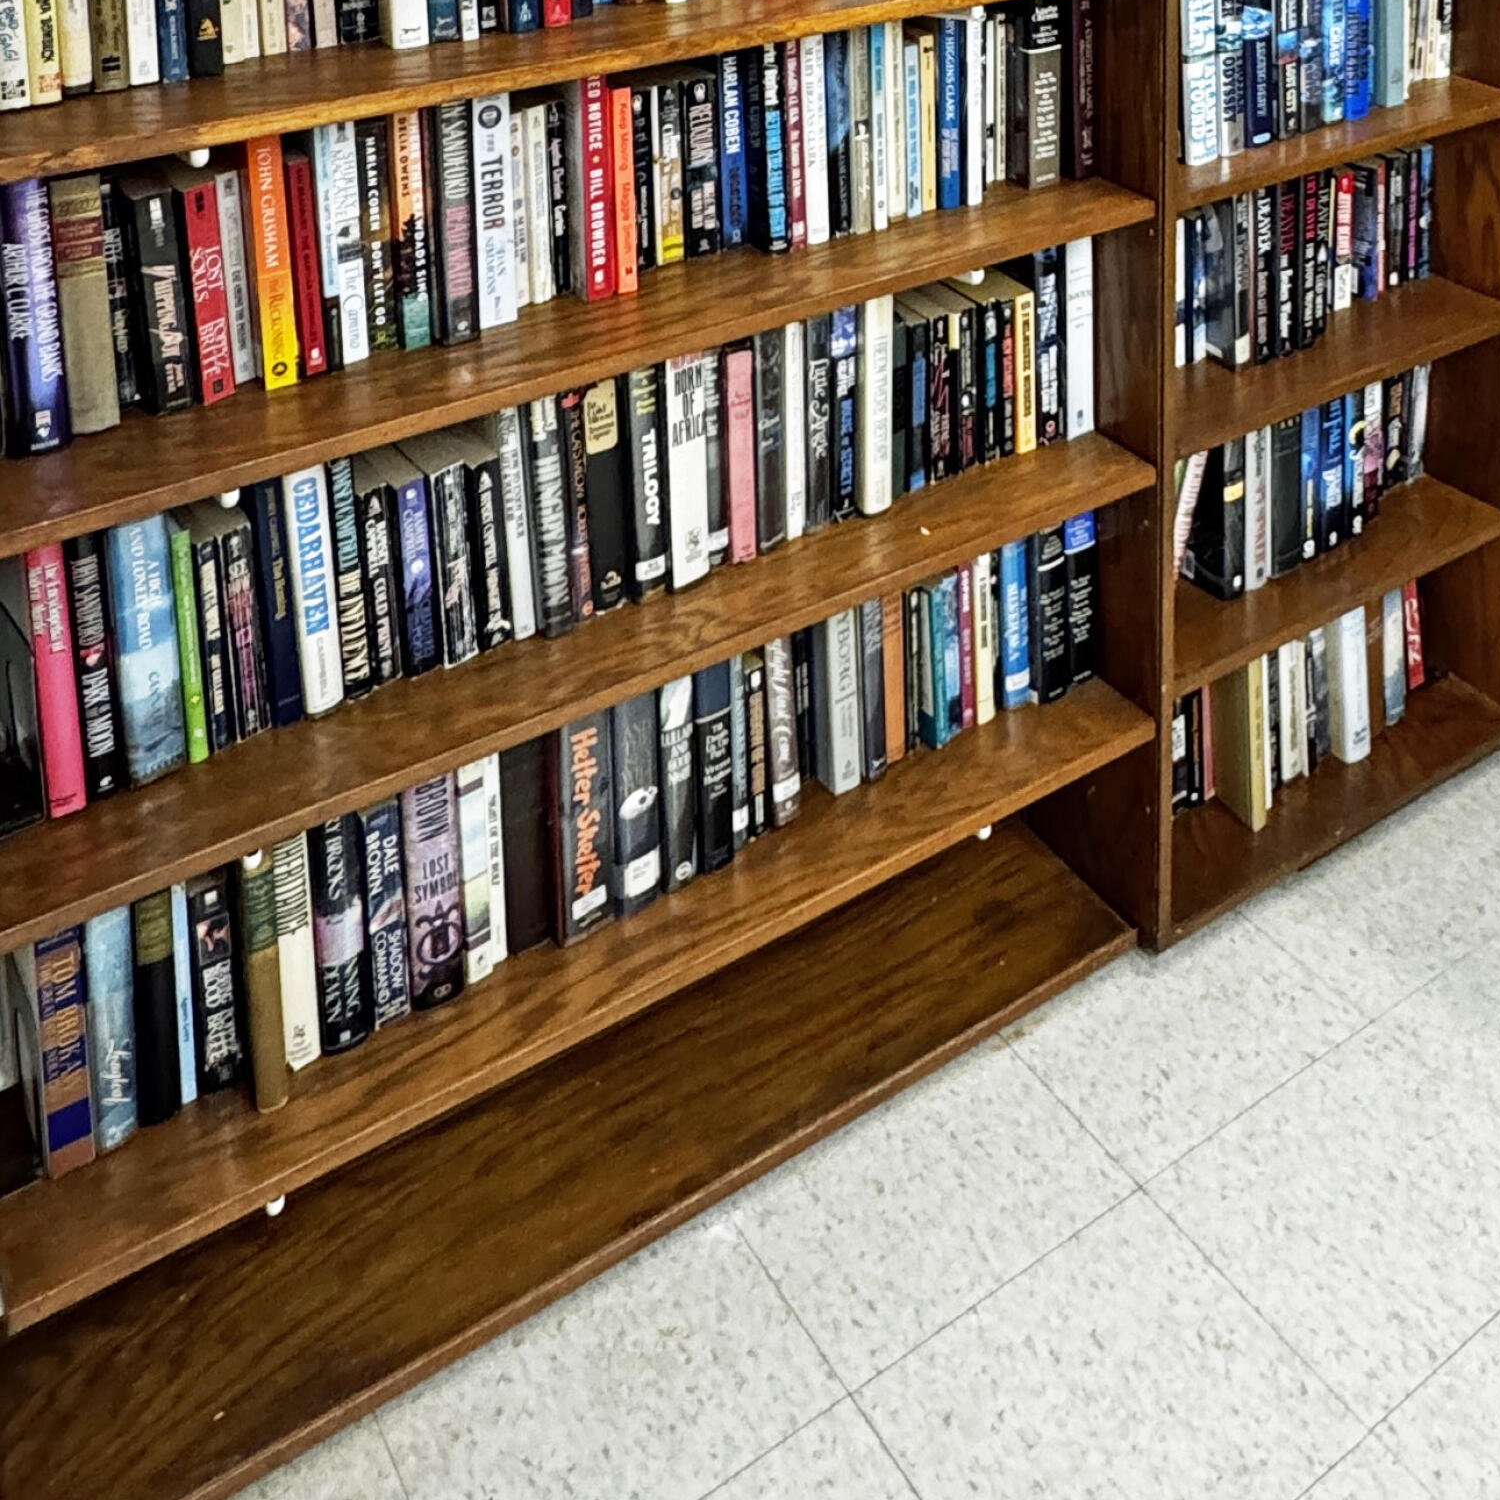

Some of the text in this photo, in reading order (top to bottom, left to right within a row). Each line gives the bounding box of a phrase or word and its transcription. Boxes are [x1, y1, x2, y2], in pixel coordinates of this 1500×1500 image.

[723, 57, 741, 154] HARLAN COBEN
[1222, 56, 1237, 124] ODYSSEY
[397, 117, 410, 198] DELIA OWENS
[441, 122, 470, 200] SANDFORD
[689, 103, 714, 169] RELIQUARY
[256, 146, 279, 269] JOHN GRISHAM
[365, 137, 381, 231] HARLAN COBEN
[481, 155, 506, 231] TERROR
[588, 102, 606, 267] NOTICE BILL BROWDER
[190, 248, 209, 304] SOULS
[205, 246, 223, 291] LOST
[371, 241, 386, 325] DON'T LET GO
[446, 206, 473, 299] DEAD WATCH
[674, 366, 702, 394] HORN
[683, 397, 696, 418] OF
[672, 416, 706, 448] AFRICA
[641, 429, 660, 525] TRILOGY
[293, 477, 329, 636] CEDARHAVEN
[415, 776, 447, 843] BROWN
[570, 727, 601, 896] Helter Skelter
[367, 832, 384, 897] BROWN
[383, 835, 400, 876] DALE
[415, 873, 458, 903] SYMBOL
[422, 853, 450, 881] LOST
[52, 958, 77, 1004] TOM
